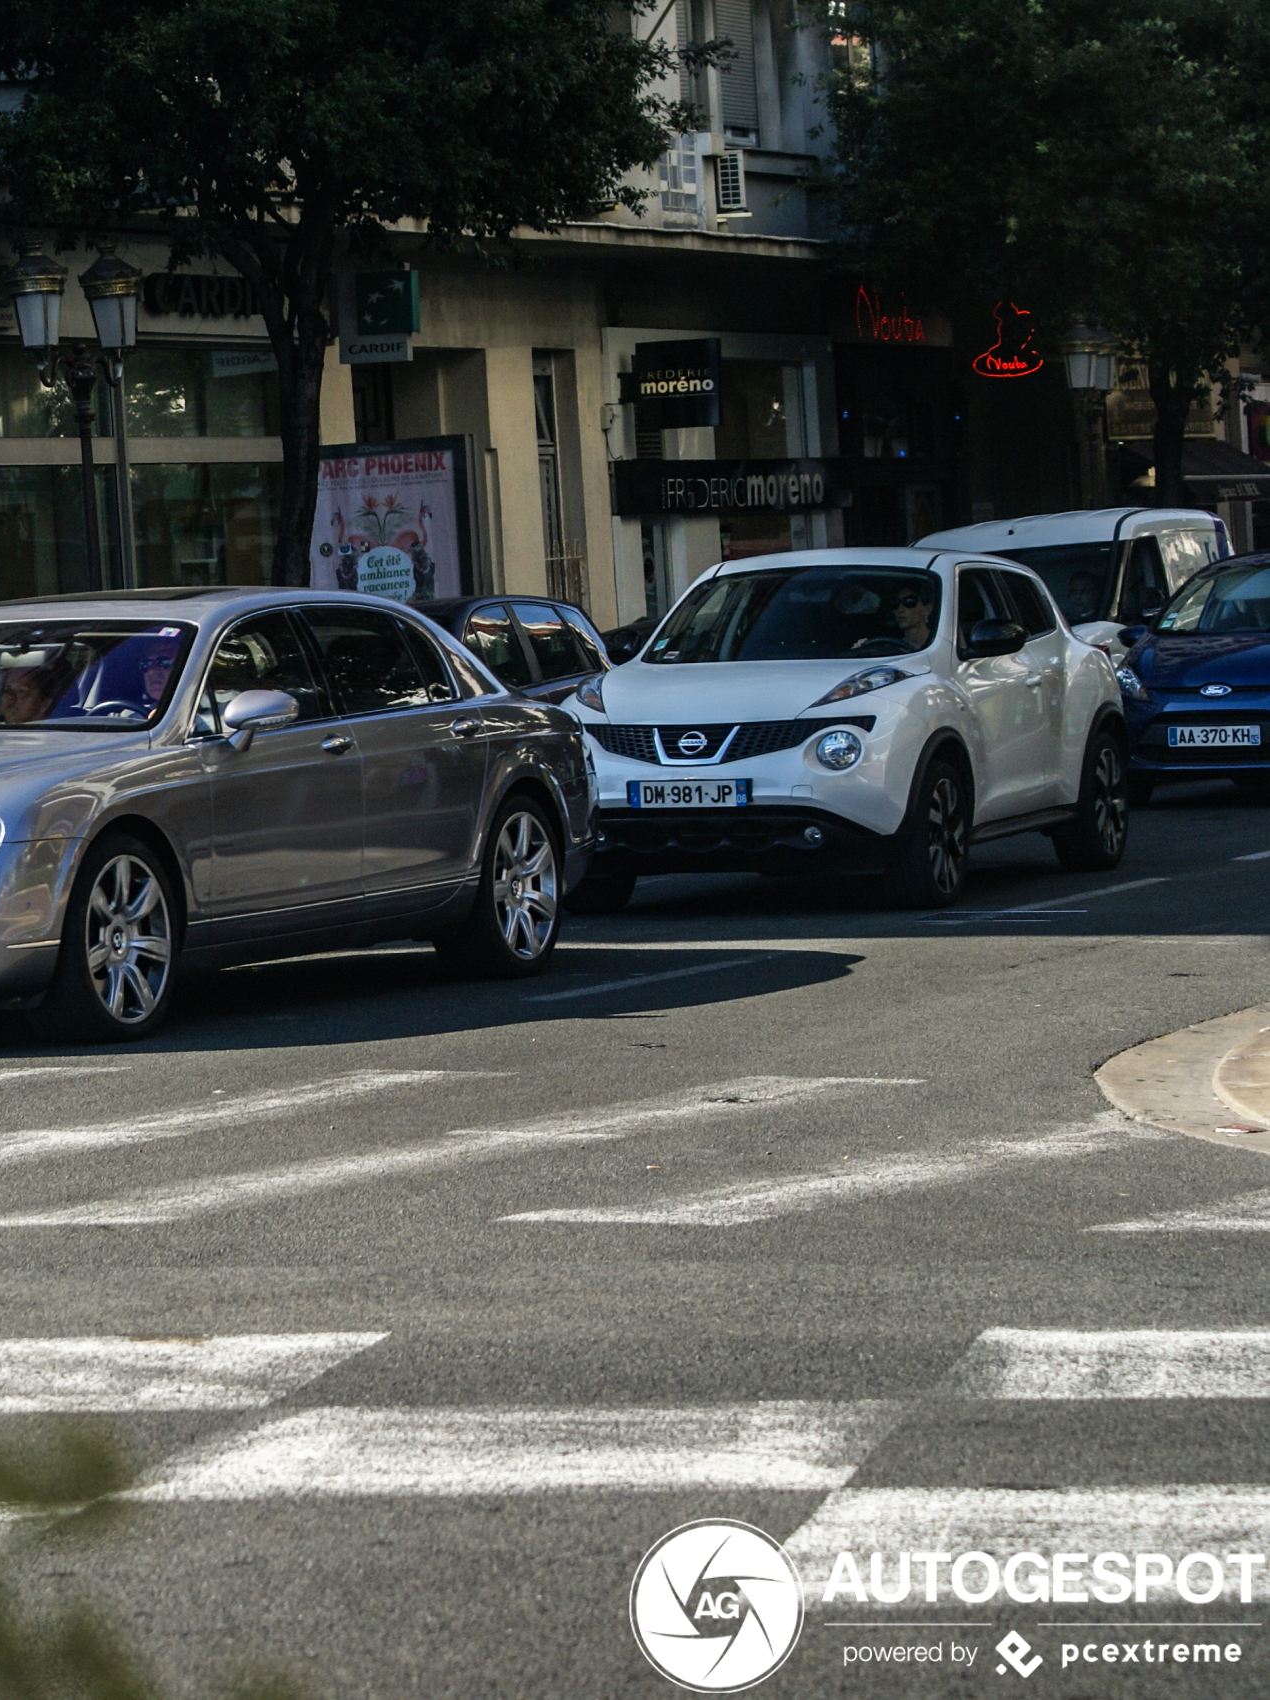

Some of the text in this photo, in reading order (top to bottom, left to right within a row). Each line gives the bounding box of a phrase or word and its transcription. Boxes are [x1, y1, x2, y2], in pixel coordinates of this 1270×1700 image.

[856, 284, 926, 342] Nouba
[347, 341, 406, 356] CARDIF
[985, 354, 1029, 371] Nouba
[640, 376, 715, 395] moréno
[318, 451, 447, 479] ARC PHOENIX
[366, 553, 401, 569] Cet été
[360, 567, 411, 582] ambiance
[363, 578, 410, 593] vacances
[643, 785, 733, 804] DM-981-JP
[736, 794, 747, 804] 06
